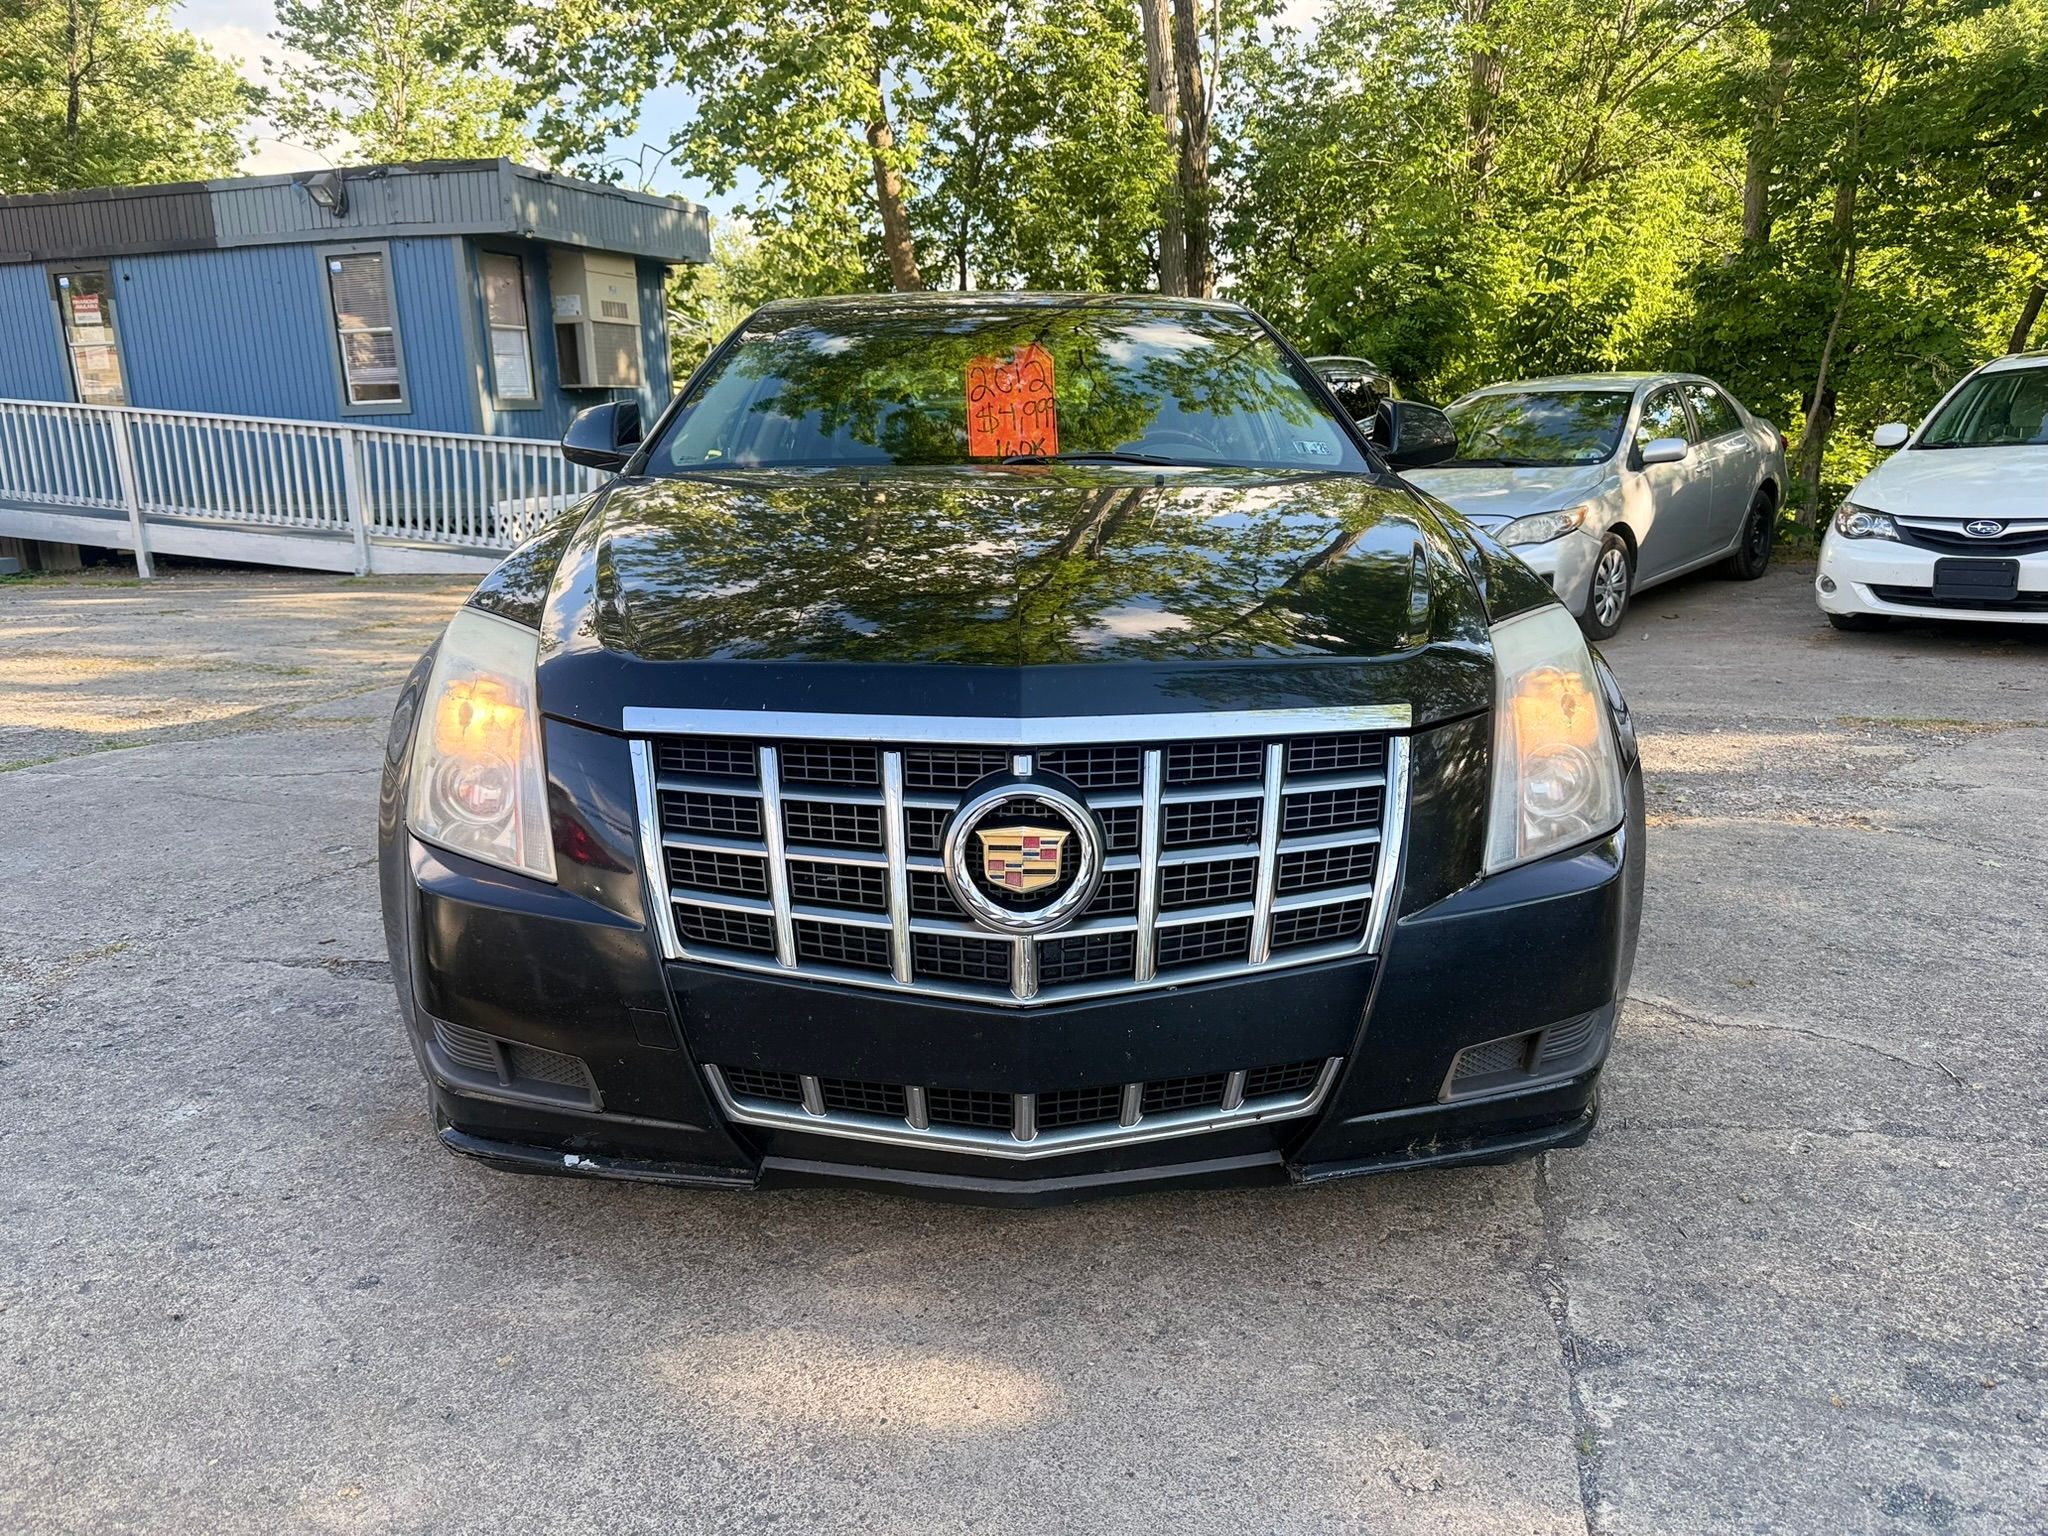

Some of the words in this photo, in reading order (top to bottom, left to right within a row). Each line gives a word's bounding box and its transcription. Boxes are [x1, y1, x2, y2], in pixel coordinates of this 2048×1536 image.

[970, 360, 1054, 402] 2012
[975, 396, 1055, 435] $4,999
[995, 437, 1047, 457] 160K
